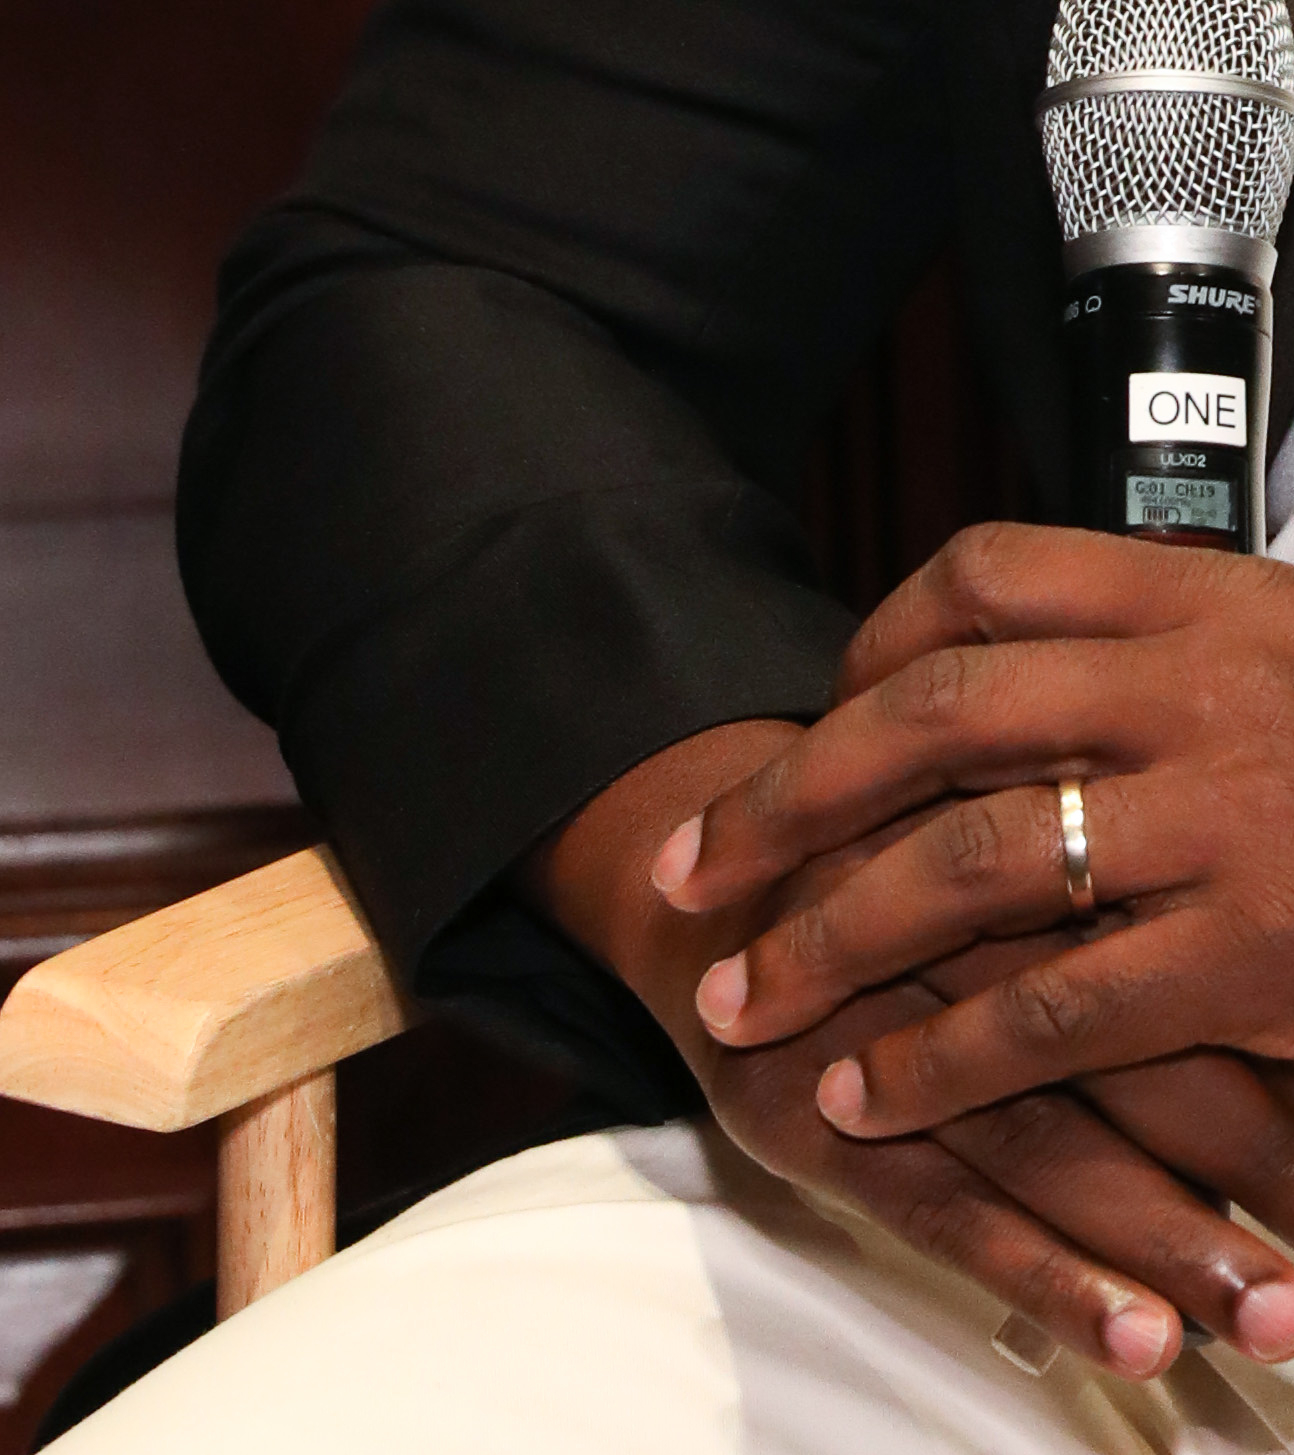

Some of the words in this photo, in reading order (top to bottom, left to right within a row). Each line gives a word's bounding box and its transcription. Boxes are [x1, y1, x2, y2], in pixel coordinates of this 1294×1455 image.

[1168, 283, 1256, 316] SHURE
[1148, 390, 1237, 430] ONE
[1160, 452, 1207, 468] ULXD2
